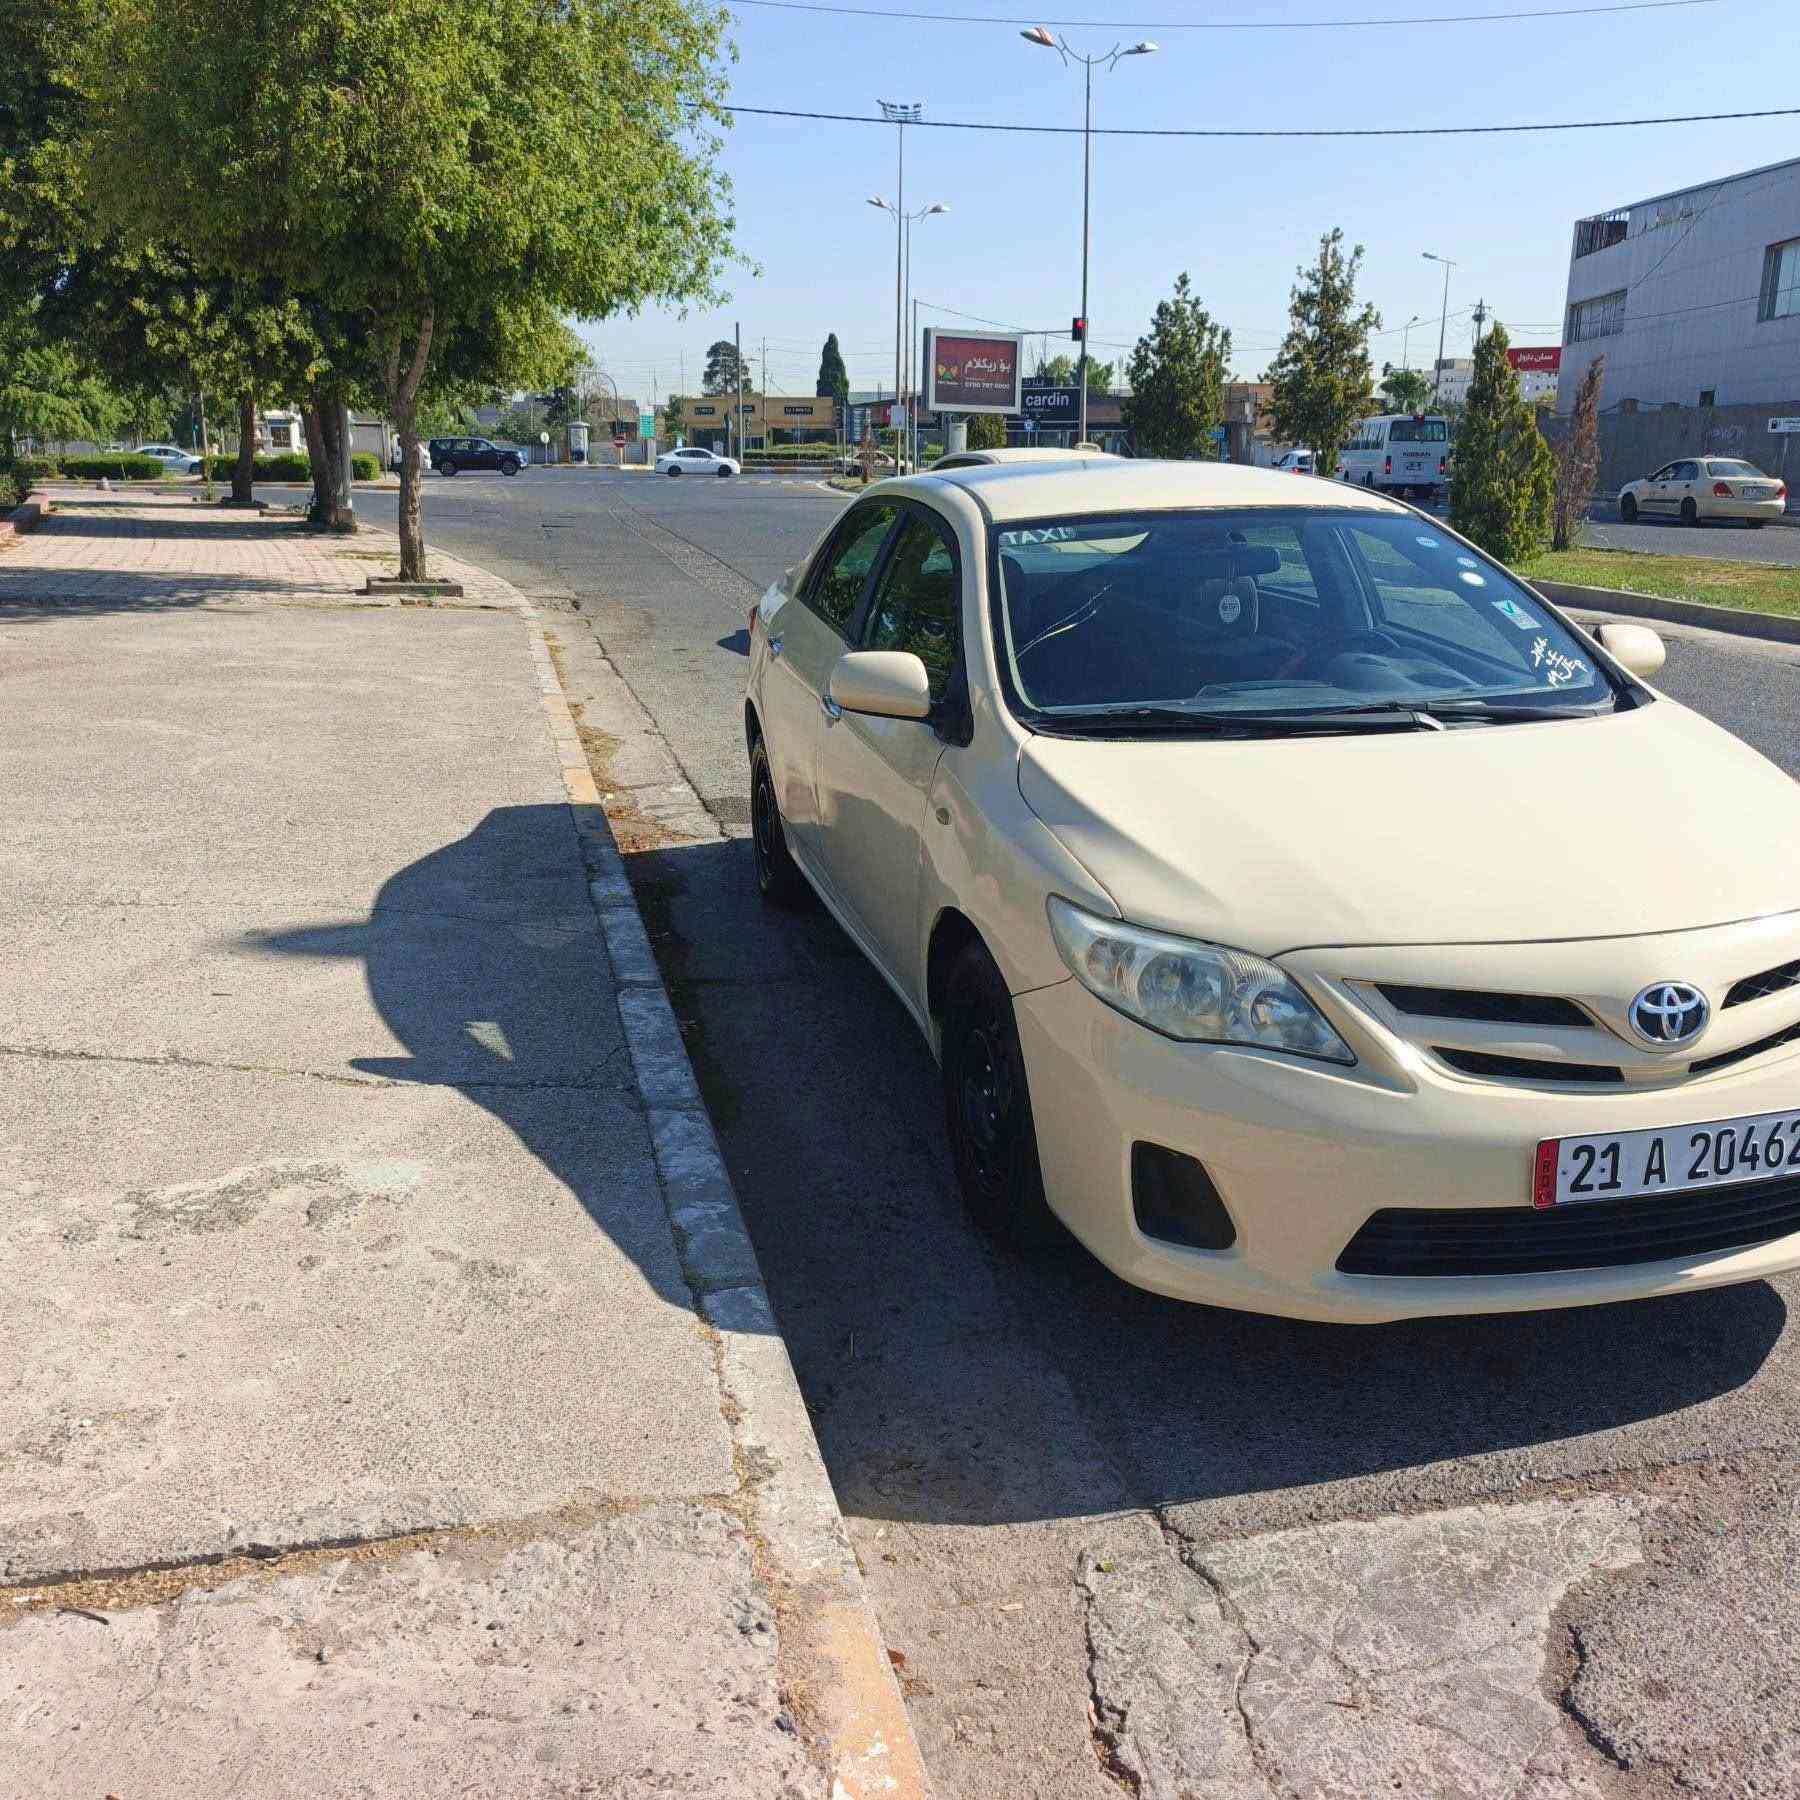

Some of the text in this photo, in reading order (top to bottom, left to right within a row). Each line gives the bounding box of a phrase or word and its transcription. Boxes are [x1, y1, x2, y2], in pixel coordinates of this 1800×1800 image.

[1025, 391, 1070, 407] cardin
[1002, 526, 1069, 545] TAXI
[1569, 1119, 1800, 1193] 21 A 20462
